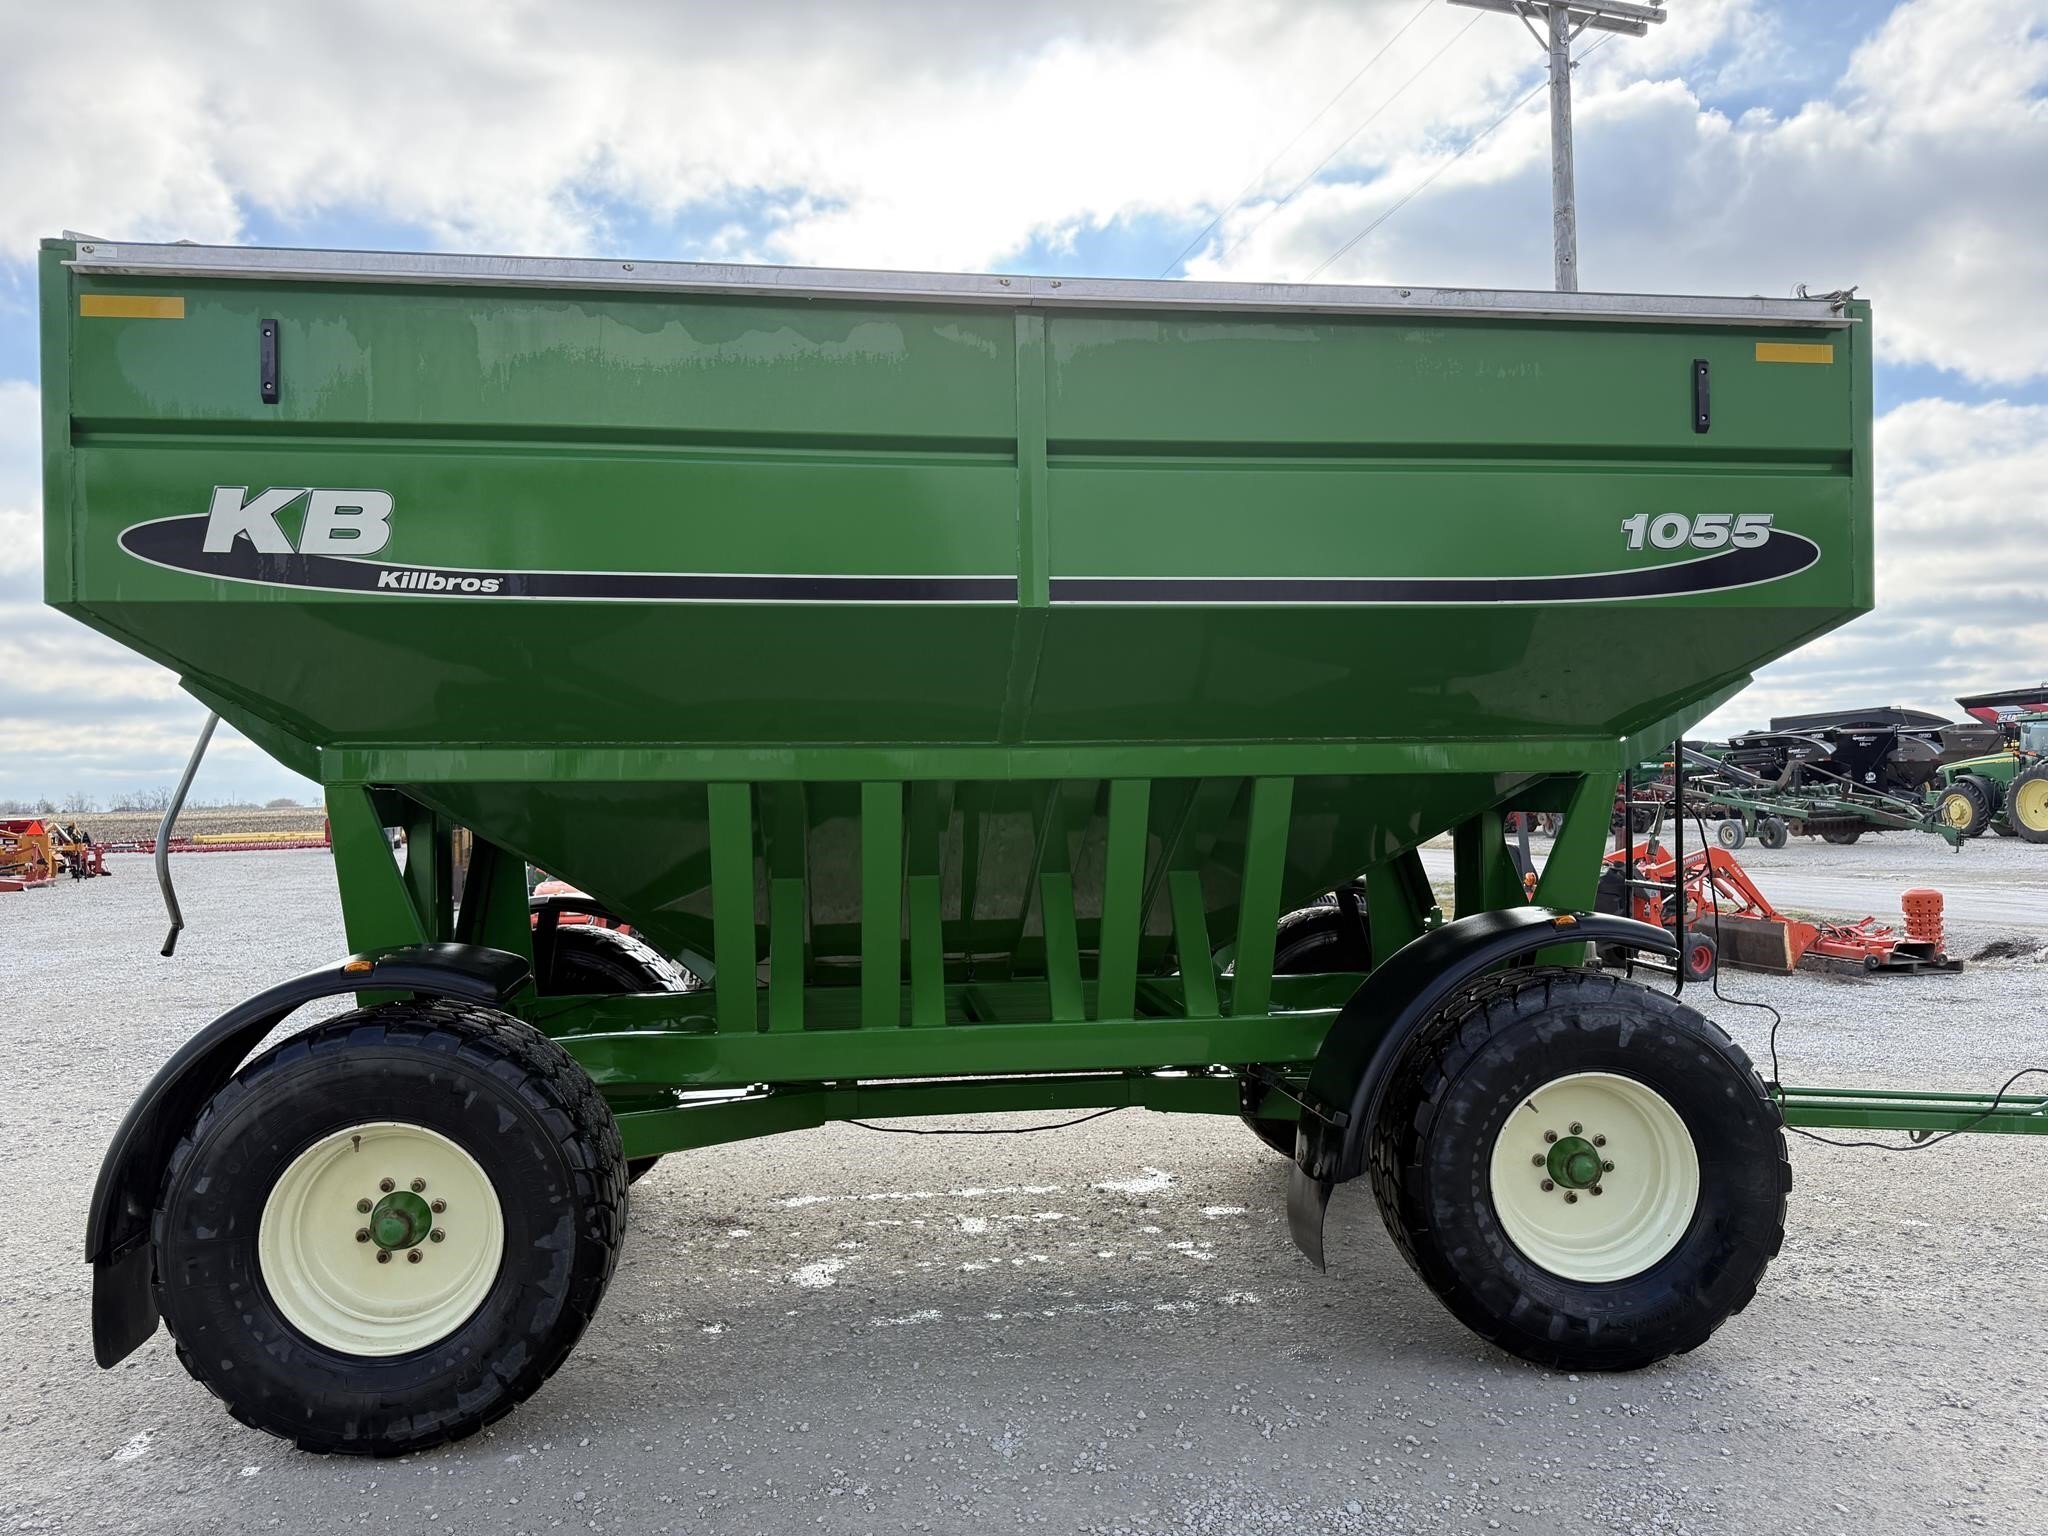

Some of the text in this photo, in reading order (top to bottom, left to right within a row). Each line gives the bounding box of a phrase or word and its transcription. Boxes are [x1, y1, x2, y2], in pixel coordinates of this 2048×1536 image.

[203, 486, 395, 555] KB
[1621, 513, 1774, 550] 1055
[377, 570, 501, 593] Killbros
